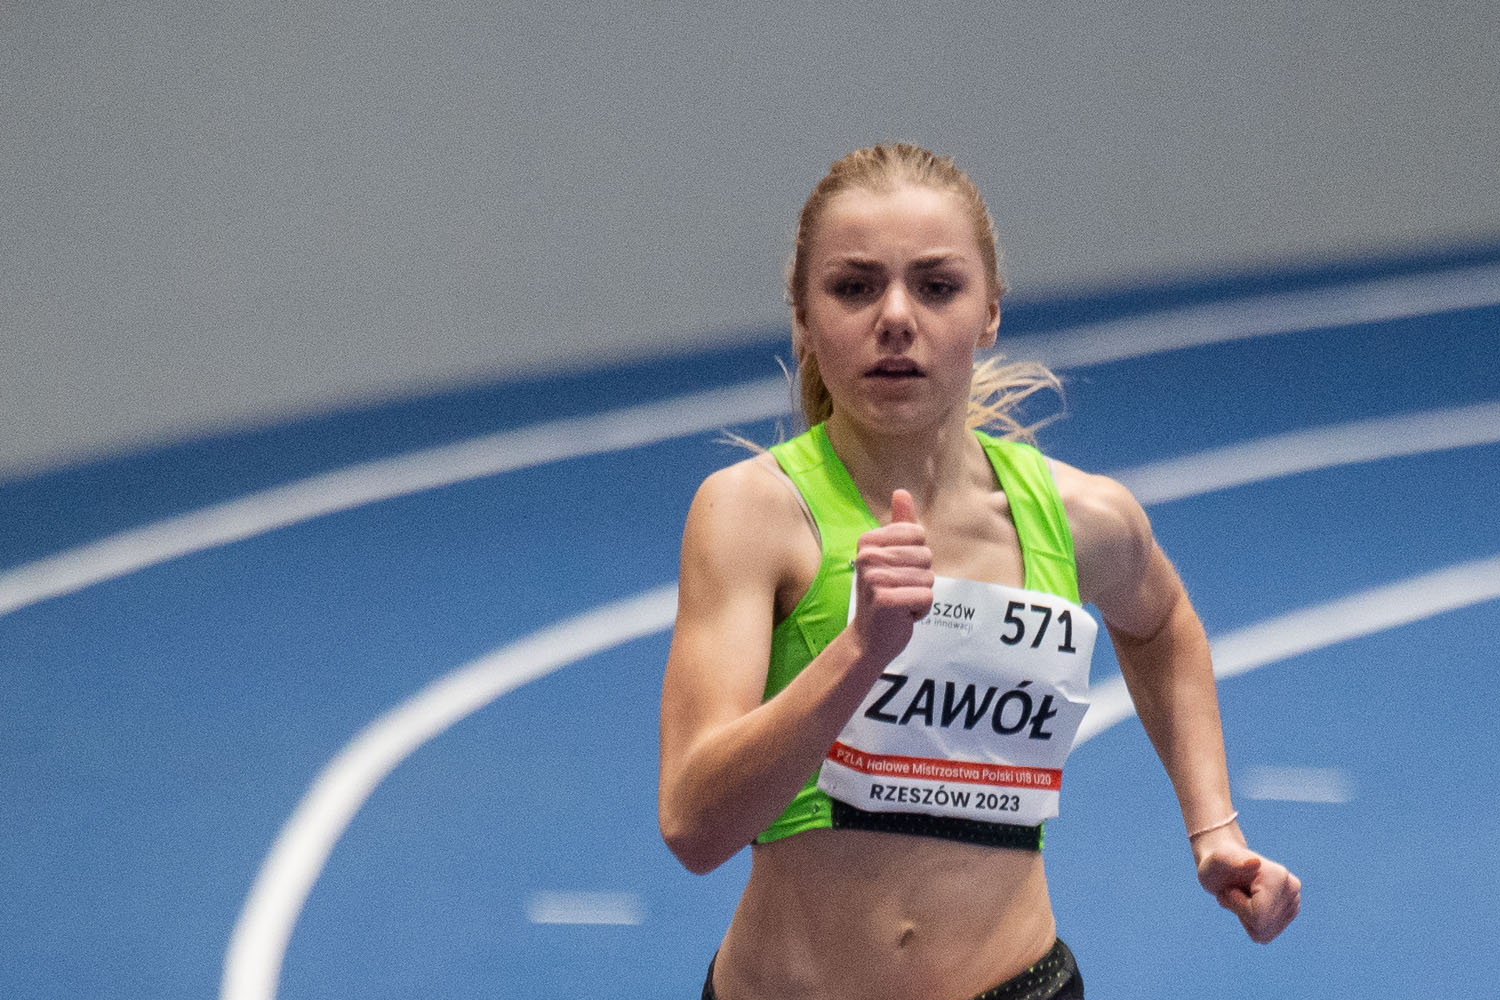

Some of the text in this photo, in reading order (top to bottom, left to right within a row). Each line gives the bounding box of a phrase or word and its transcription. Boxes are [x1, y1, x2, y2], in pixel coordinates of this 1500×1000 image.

[933, 602, 976, 621] SZÓW
[1000, 600, 1076, 654] 571
[863, 672, 1058, 741] ZAWÓŁ
[836, 748, 864, 770] PZLA
[866, 757, 910, 775] Halowe
[911, 762, 980, 782] Mistrzostwa
[981, 768, 1014, 784] Polski
[869, 783, 1022, 813] RZESZÓW 2023
